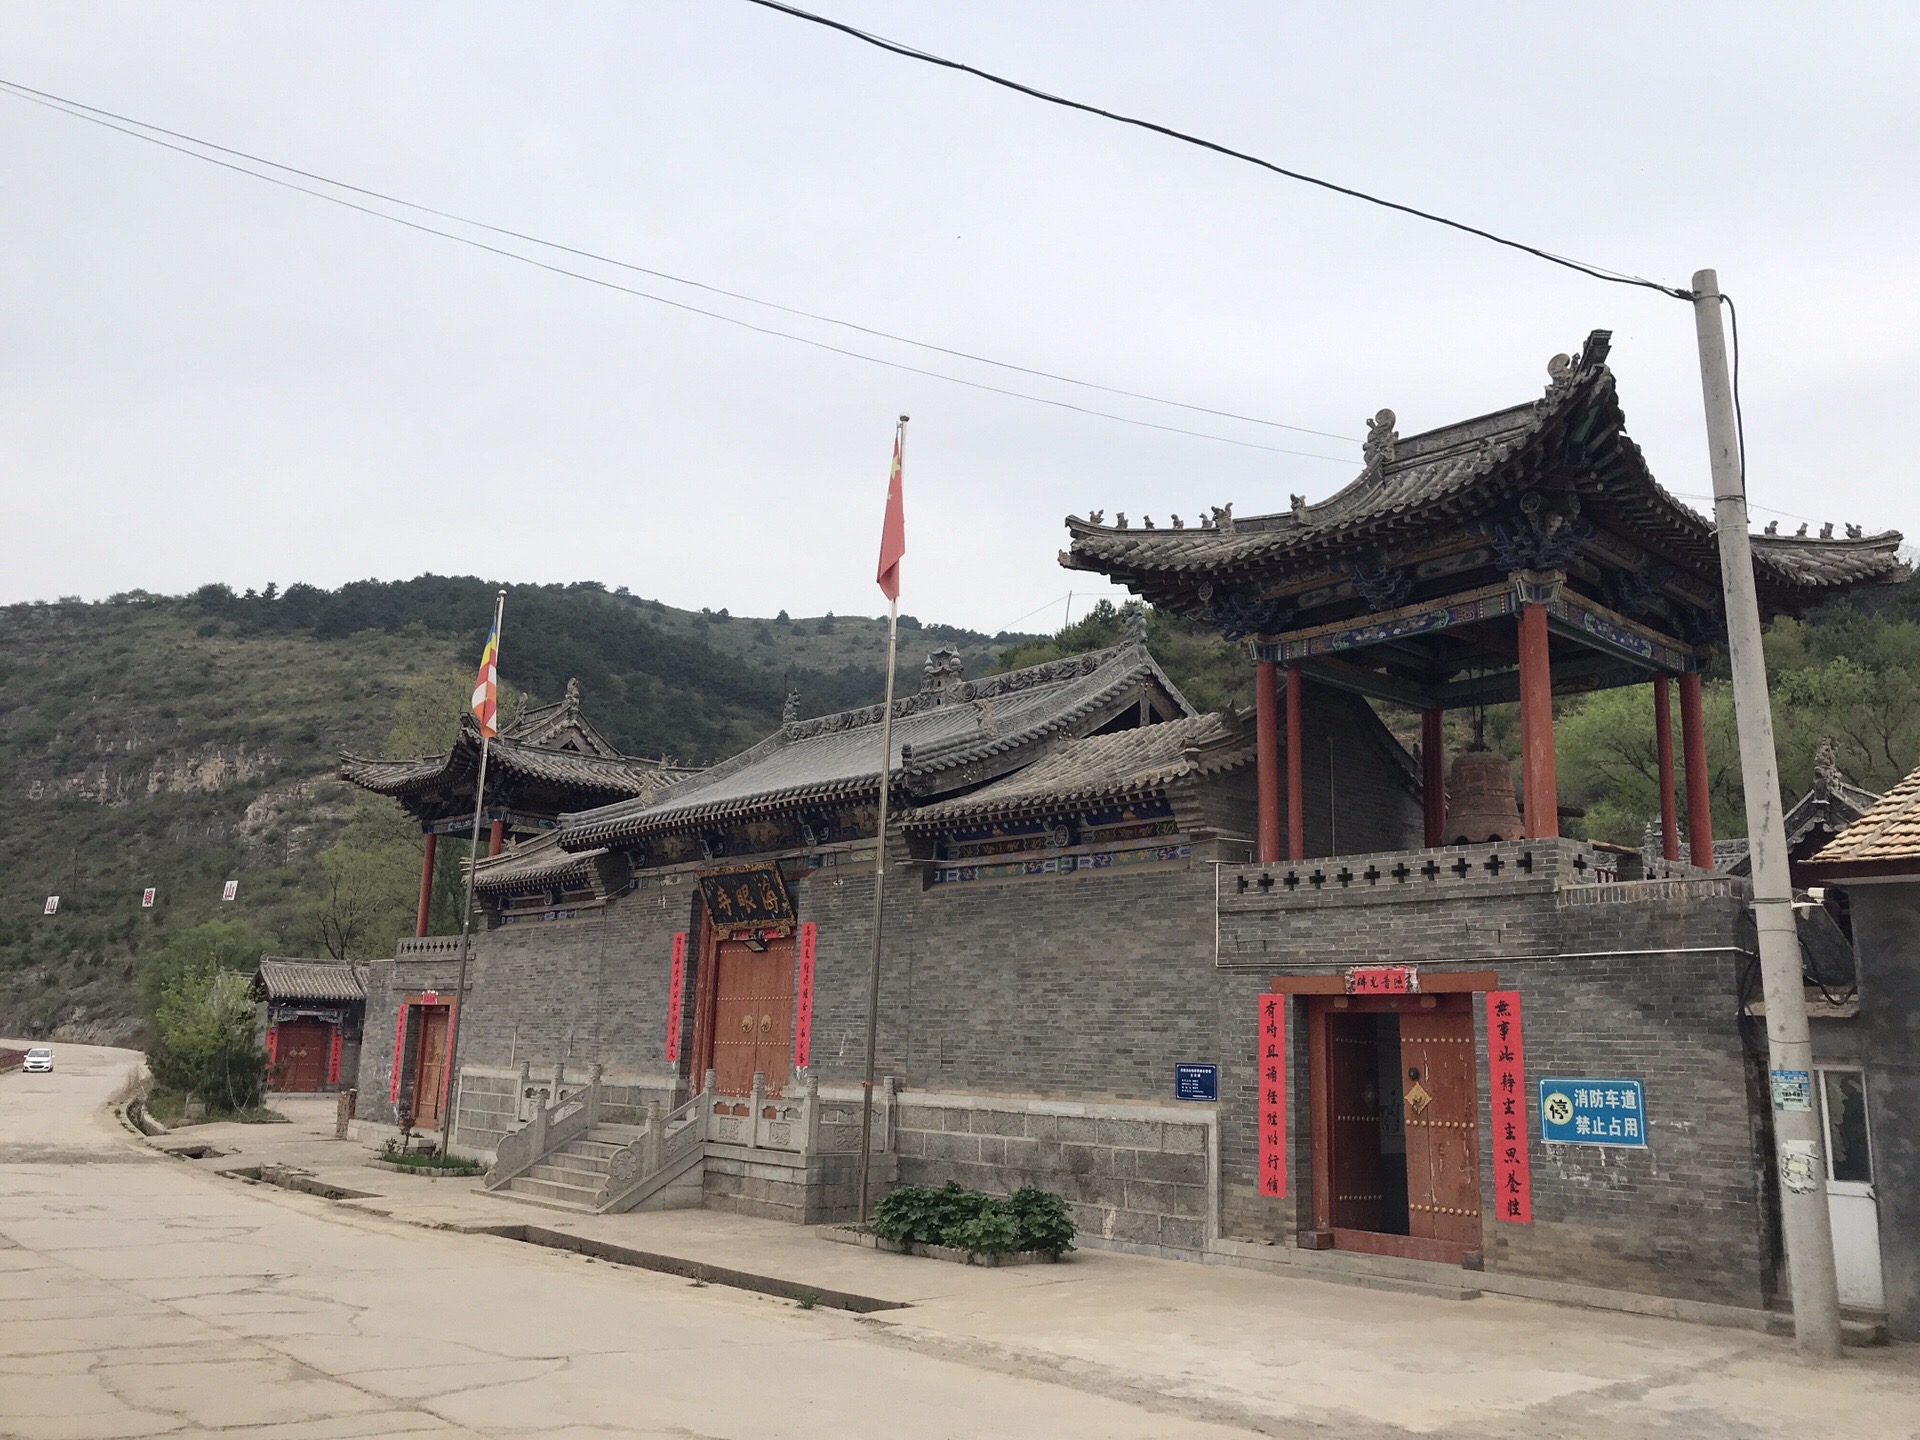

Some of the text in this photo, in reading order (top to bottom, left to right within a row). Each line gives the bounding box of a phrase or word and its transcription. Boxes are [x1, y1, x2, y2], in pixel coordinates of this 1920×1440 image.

[1548, 1098, 1569, 1120] 停
[1574, 1088, 1638, 1110] 消防车道
[1575, 1115, 1639, 1137] 禁止占用
